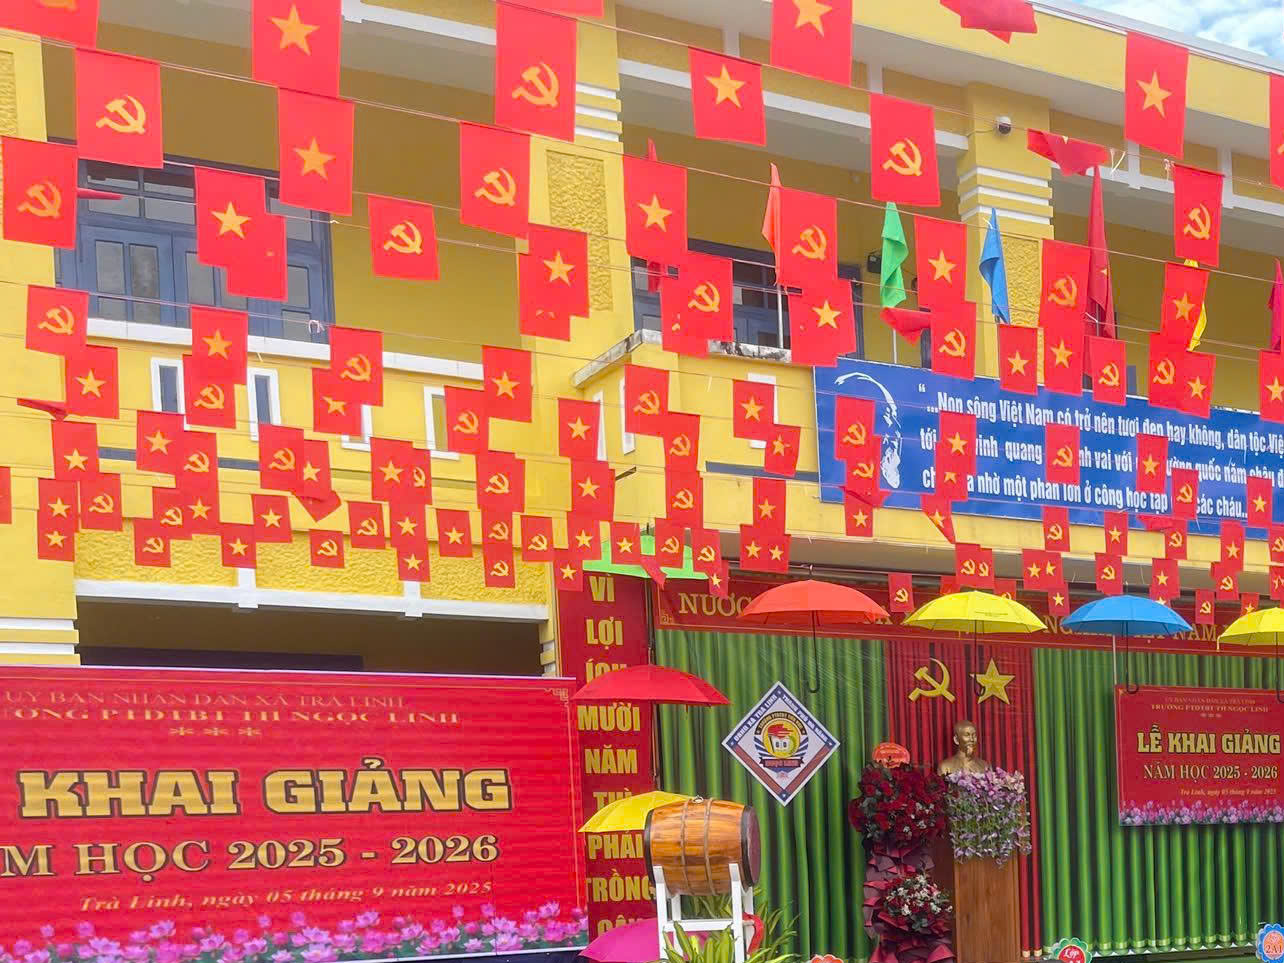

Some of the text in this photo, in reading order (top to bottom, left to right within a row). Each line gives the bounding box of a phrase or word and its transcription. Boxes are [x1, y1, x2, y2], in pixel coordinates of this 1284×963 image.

[967, 396, 996, 423] sông
[999, 399, 1023, 428] Việt
[1025, 402, 1053, 427] Nam
[1074, 408, 1091, 432] trở
[1094, 412, 1115, 436] nên
[1166, 421, 1186, 446] hay
[1188, 423, 1225, 450] không,
[1227, 429, 1247, 450] dân
[1249, 431, 1266, 456] tộc
[920, 427, 937, 450] tới
[1004, 440, 1043, 465] quang
[1094, 448, 1112, 470] vai
[1114, 450, 1133, 472] với
[1195, 457, 1221, 482] quốc
[1224, 463, 1247, 485] năm
[977, 471, 1000, 495] nhờ
[1003, 475, 1028, 501] một
[1084, 480, 1091, 503] ở
[1094, 484, 1123, 509] công
[1126, 487, 1146, 512] học
[588, 572, 615, 602] VÌ
[586, 616, 624, 650] LỢI
[577, 702, 641, 731] MƯỜI
[1137, 724, 1281, 754] LỄ KHAI GIẢNG
[584, 744, 638, 774] NĂM
[1143, 761, 1175, 779] NĂM
[1180, 765, 1210, 783] HỌC
[1213, 765, 1241, 779] 2025
[1251, 766, 1278, 779] 2026
[17, 757, 512, 819] KHAI GIẢNG
[74, 840, 211, 884] HỌC
[227, 837, 346, 871] 2025
[361, 850, 376, 859] -
[390, 835, 500, 866] 2026
[80, 896, 121, 912] Trà
[200, 892, 257, 908] ngày
[300, 887, 366, 903] tháng
[371, 886, 384, 899] 9
[391, 884, 438, 898] năm
[443, 881, 493, 896] 2025
